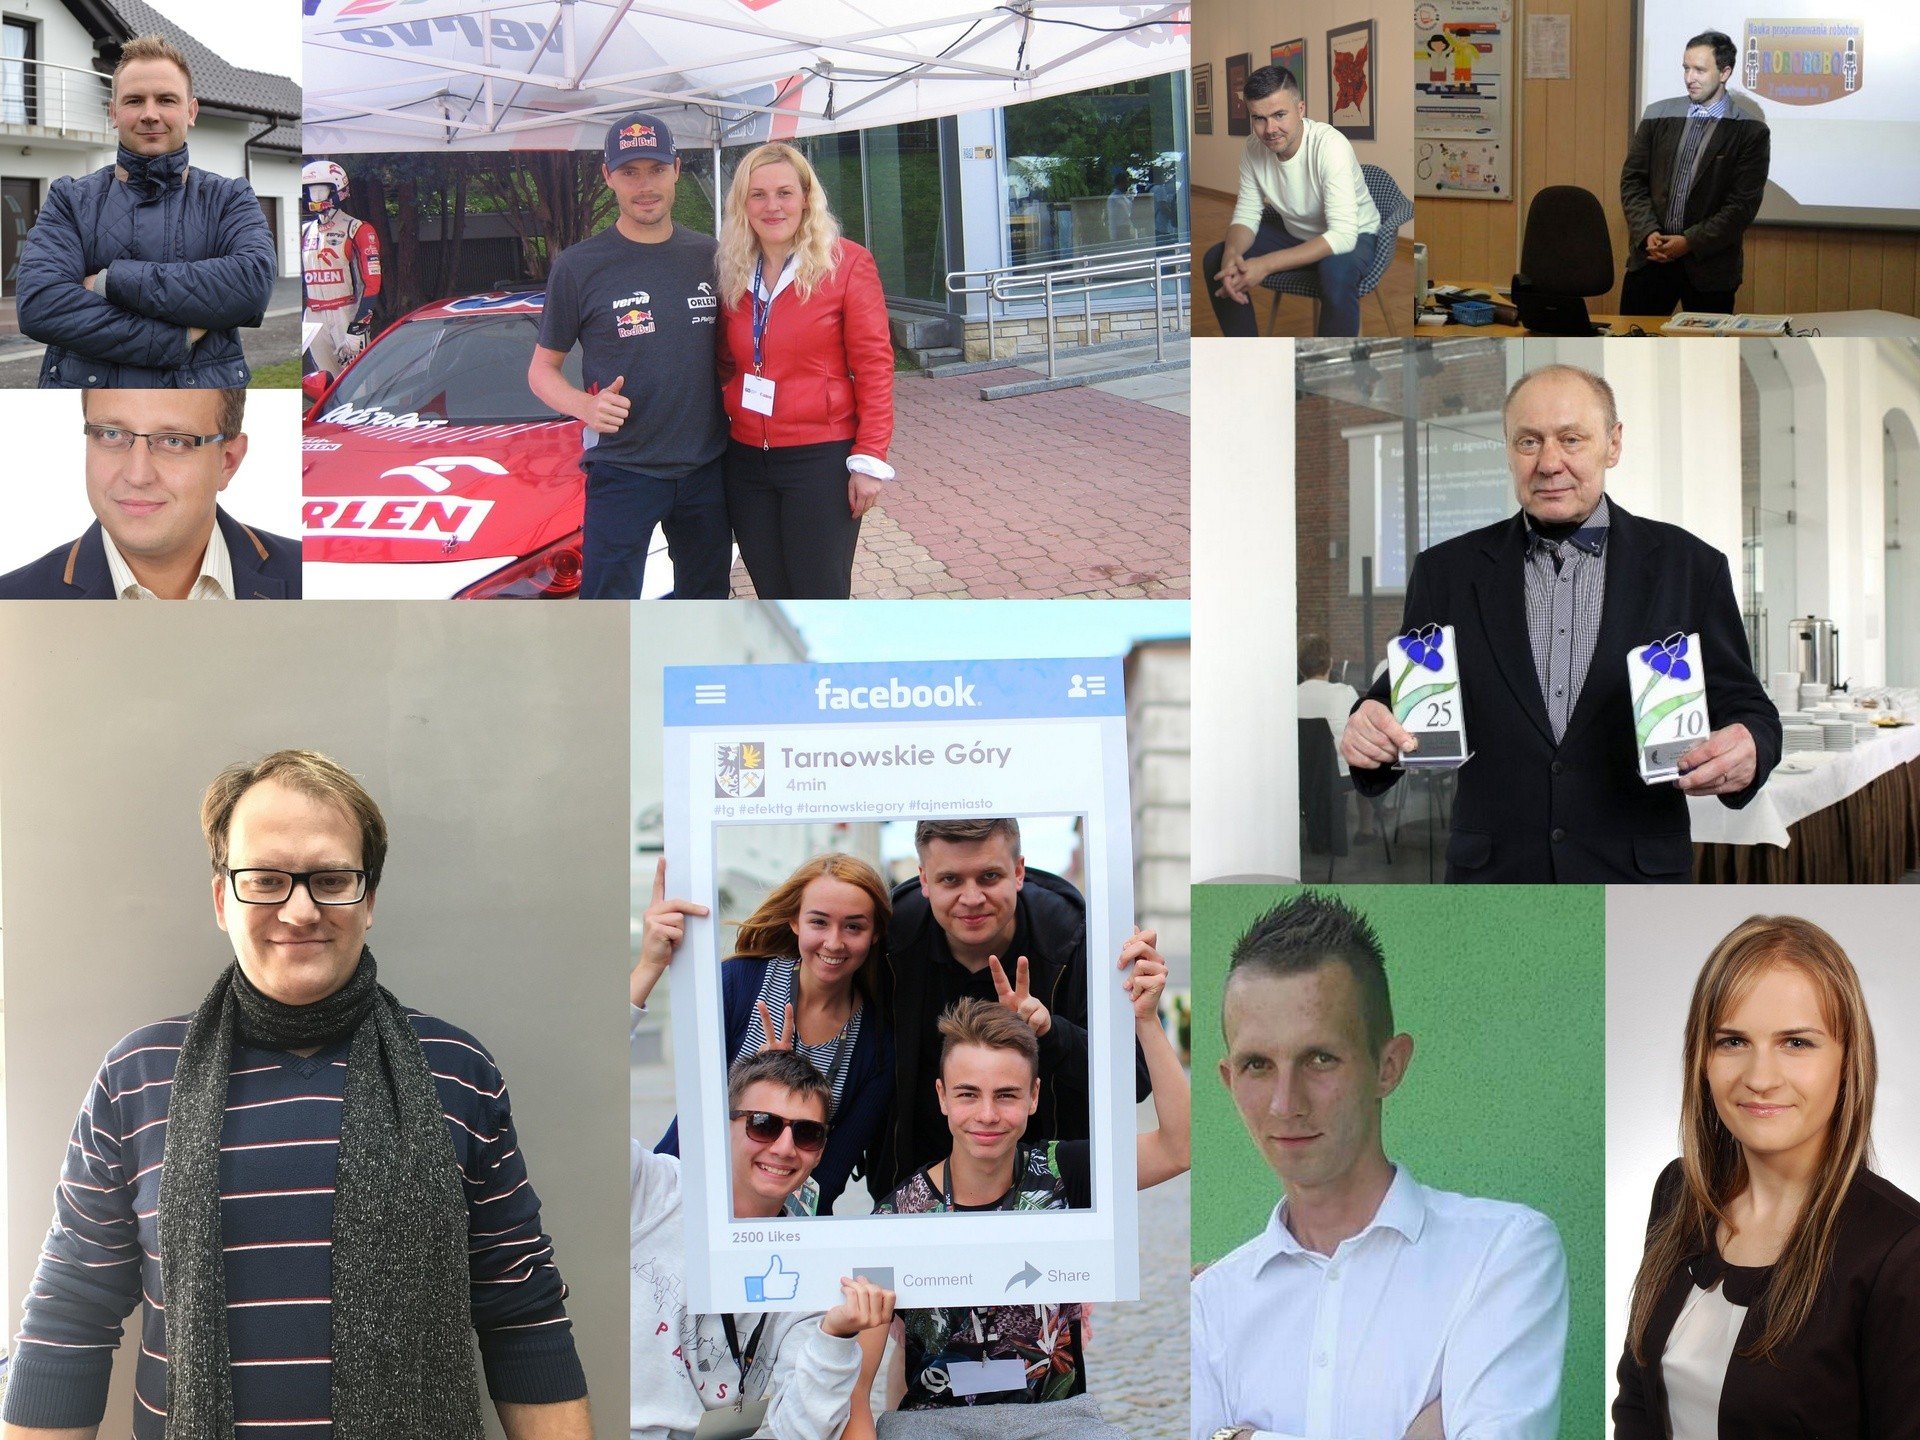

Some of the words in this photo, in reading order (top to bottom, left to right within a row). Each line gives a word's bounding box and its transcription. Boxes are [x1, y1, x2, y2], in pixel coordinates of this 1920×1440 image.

[620, 137, 638, 150] Red
[638, 137, 657, 147] Bull
[305, 271, 341, 284] ORLEN
[612, 294, 650, 309] verva
[690, 297, 716, 307] ORLEN
[618, 325, 638, 338] Red
[637, 322, 656, 335] Bull
[815, 676, 976, 710] facebook
[1426, 701, 1452, 728] 25
[1675, 710, 1704, 739] 10
[781, 744, 935, 768] Tarnowskie
[945, 740, 1012, 768] Góry
[786, 778, 827, 792] 4min
[714, 804, 735, 817] #tg
[739, 802, 793, 816] #efekttg
[797, 800, 905, 815] #tarnowskiegory
[908, 798, 994, 812] #fajnemiasto
[732, 1231, 764, 1243] 2500
[768, 1230, 801, 1242] Likes
[903, 1273, 974, 1287] Comment
[1047, 1269, 1091, 1283] Share
